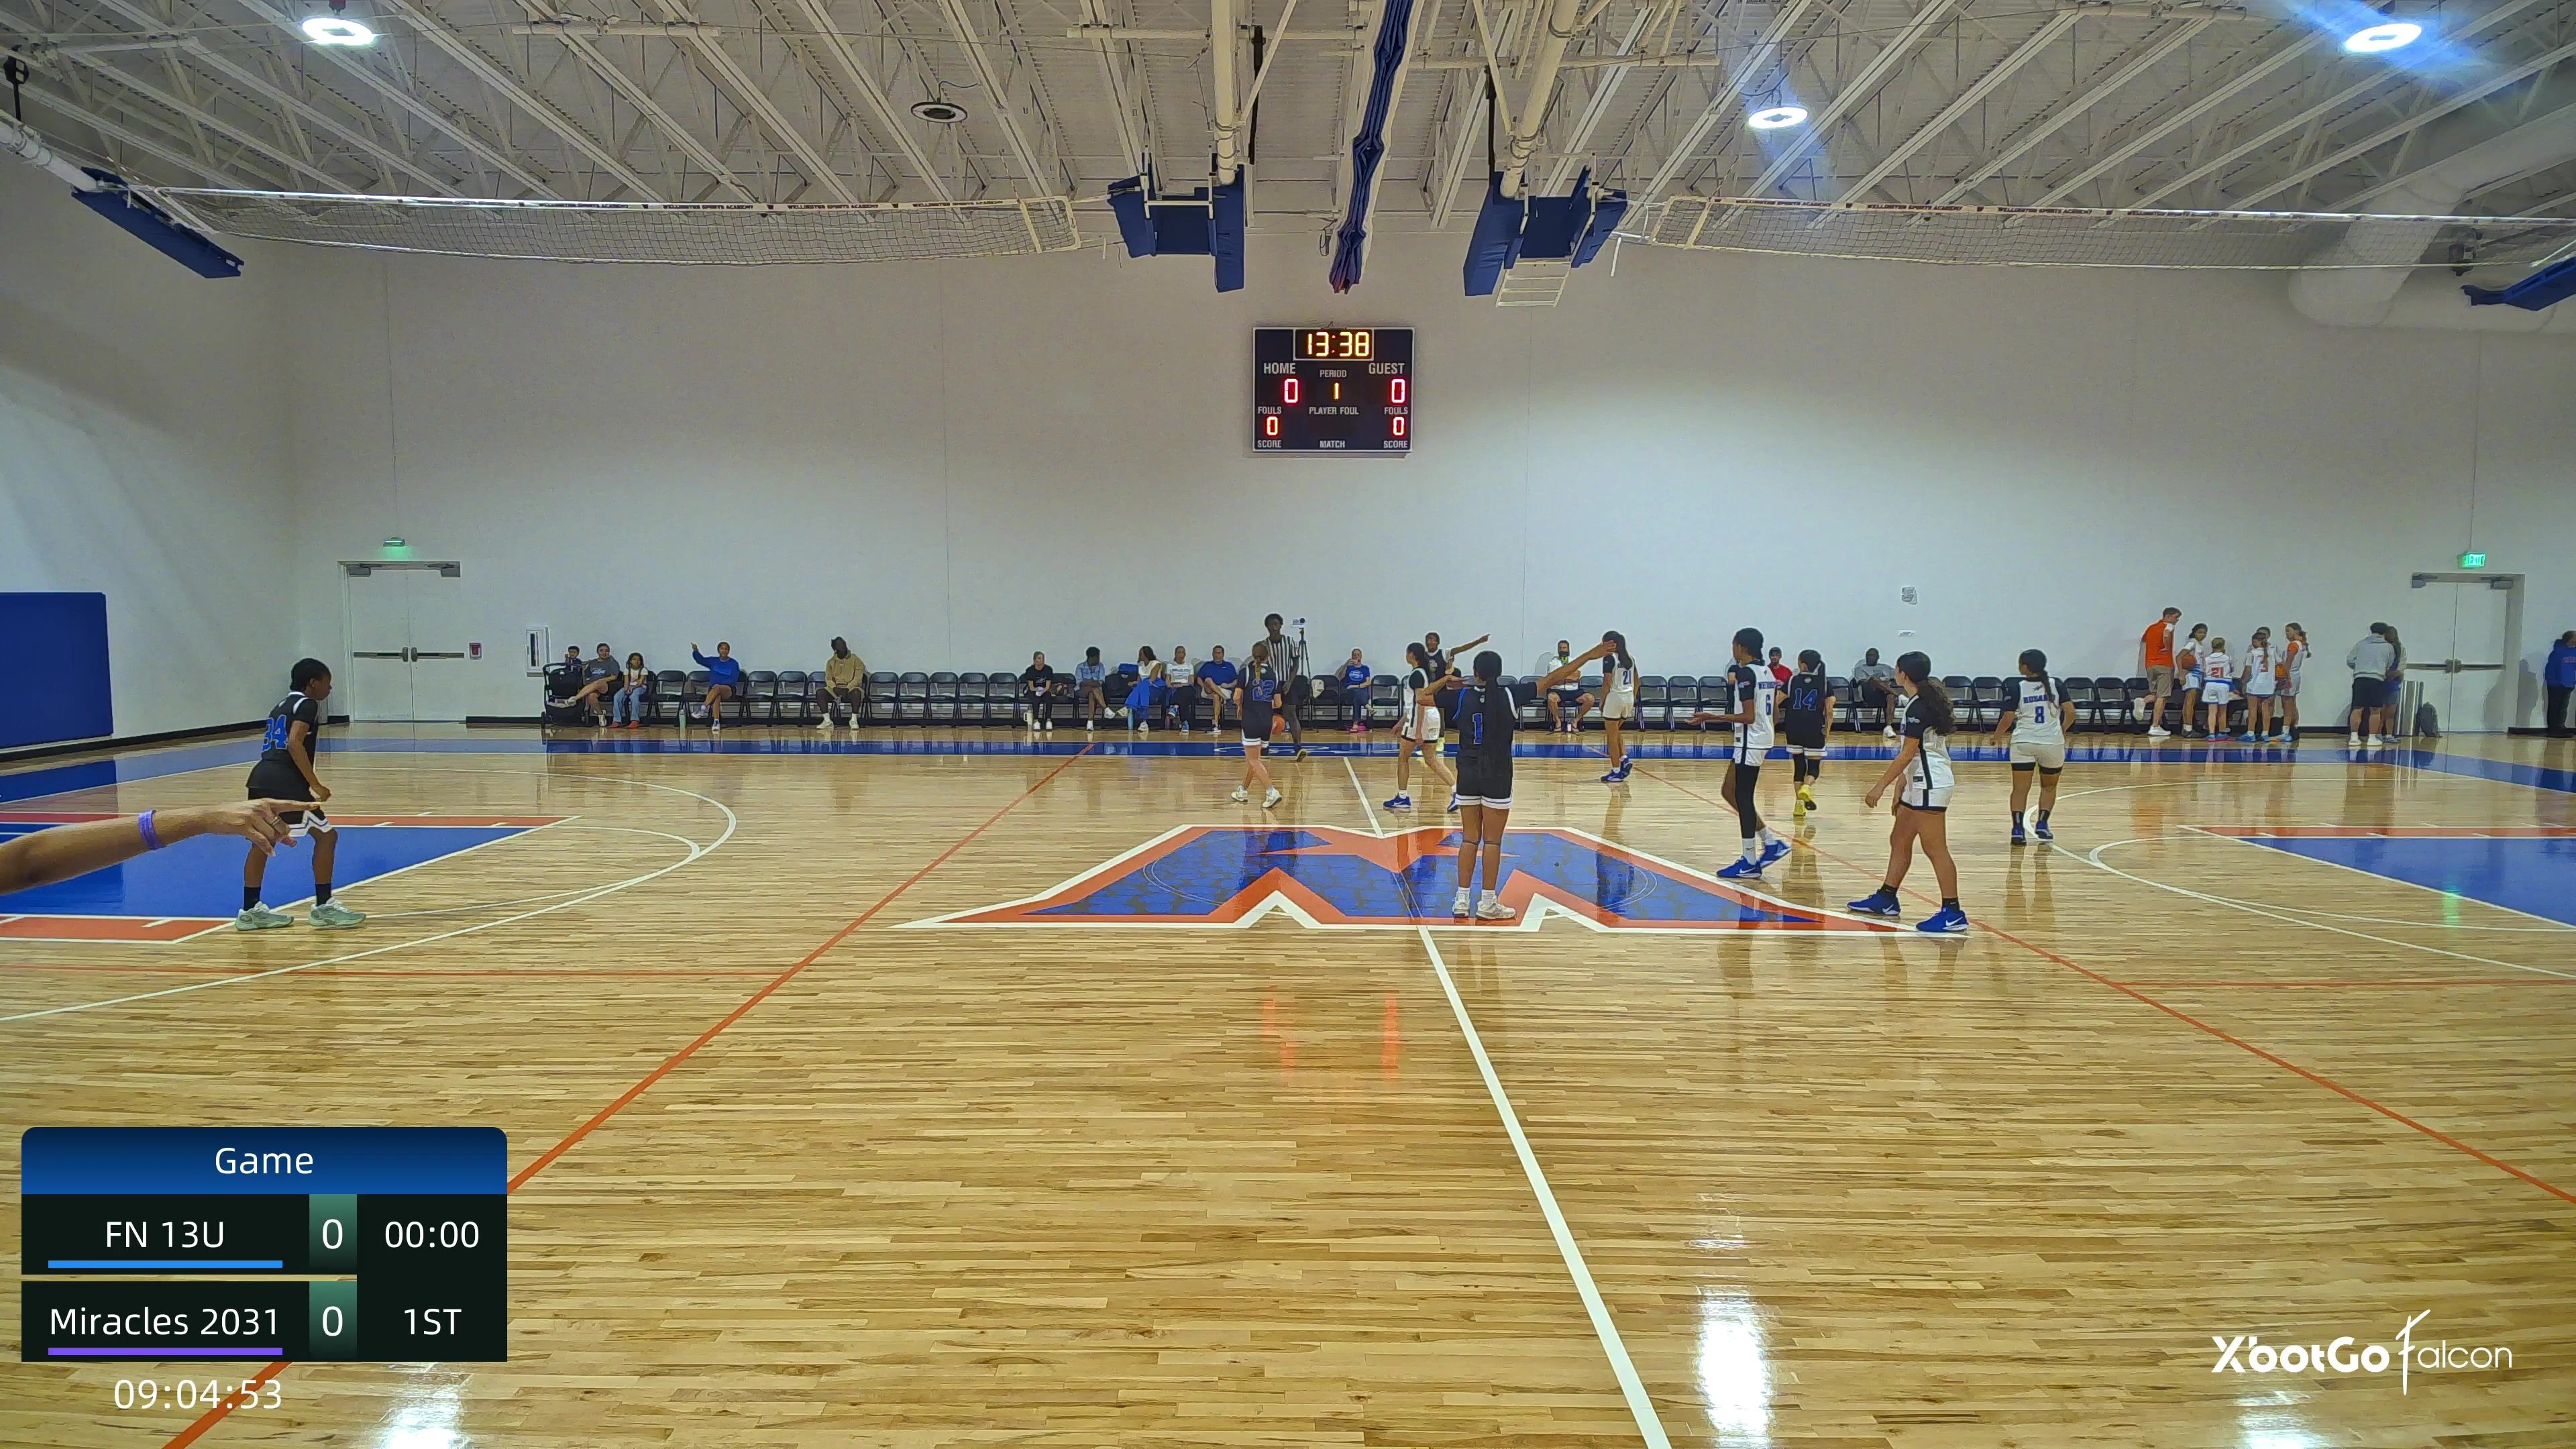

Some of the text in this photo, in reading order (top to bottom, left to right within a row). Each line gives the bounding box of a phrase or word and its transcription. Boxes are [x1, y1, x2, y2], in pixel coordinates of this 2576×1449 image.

[1307, 331, 1370, 357] 13:38
[1263, 362, 1296, 374] HOME
[1319, 370, 1347, 378] PERIOD
[1368, 362, 1405, 374] GUEST
[1284, 378, 1299, 403] 0
[1334, 382, 1340, 400] 1
[1391, 378, 1405, 403] 0
[1309, 407, 1337, 415] PLAYER
[1384, 407, 1408, 415] FOULS
[1266, 416, 1279, 436] 0
[1393, 416, 1405, 436] 0
[1257, 440, 1282, 448] SCORE
[1319, 440, 1346, 448] MATCH
[1383, 440, 1408, 448] SCORE
[1766, 694, 1772, 716] 6
[1792, 688, 1818, 711] 14
[2035, 706, 2045, 724] 8
[262, 714, 288, 752] 34
[1472, 712, 1483, 744] 1
